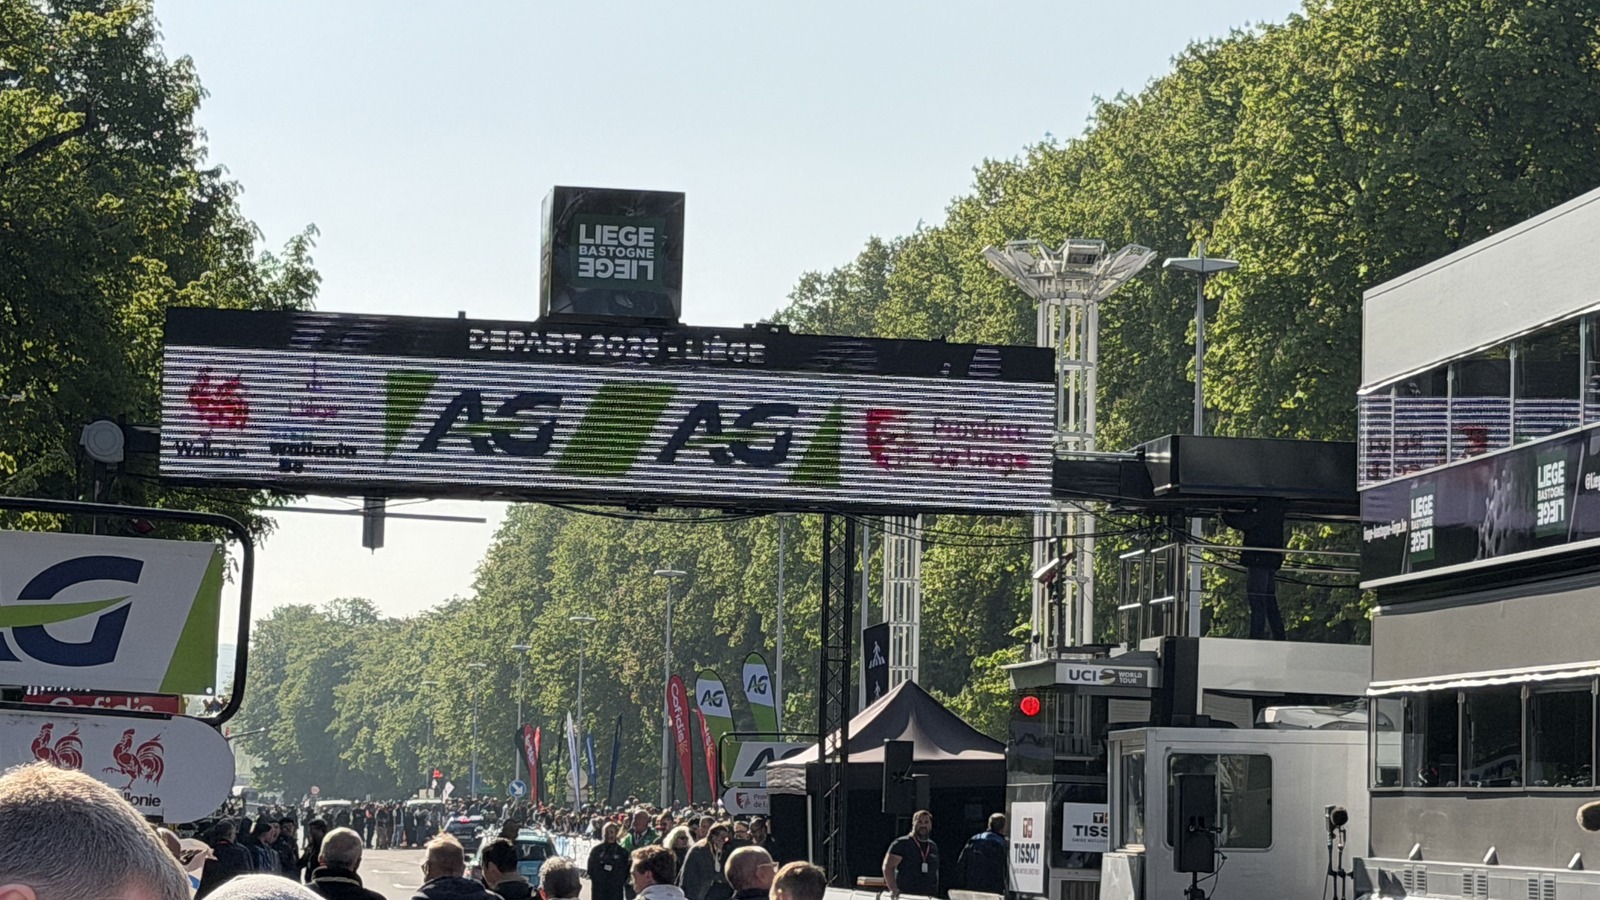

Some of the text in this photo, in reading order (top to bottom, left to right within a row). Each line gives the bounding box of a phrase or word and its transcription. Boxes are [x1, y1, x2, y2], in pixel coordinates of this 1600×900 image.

[579, 224, 655, 247] LIEGE
[579, 246, 655, 258] BASTOGNE
[578, 257, 655, 281] LIEGE
[416, 389, 564, 456] AG
[655, 402, 800, 467] AG
[1537, 460, 1565, 489] LIEGE
[1410, 494, 1433, 519] LIEGE
[1537, 498, 1565, 526] LIEGE
[1410, 528, 1433, 553] LIEGE
[0, 555, 144, 667] G
[747, 674, 768, 695] AG
[1069, 669, 1096, 681] UCI
[701, 689, 724, 708] AG
[671, 683, 685, 743] Cofidis
[1073, 825, 1108, 837] TISS
[1014, 843, 1040, 864] TISSOT
